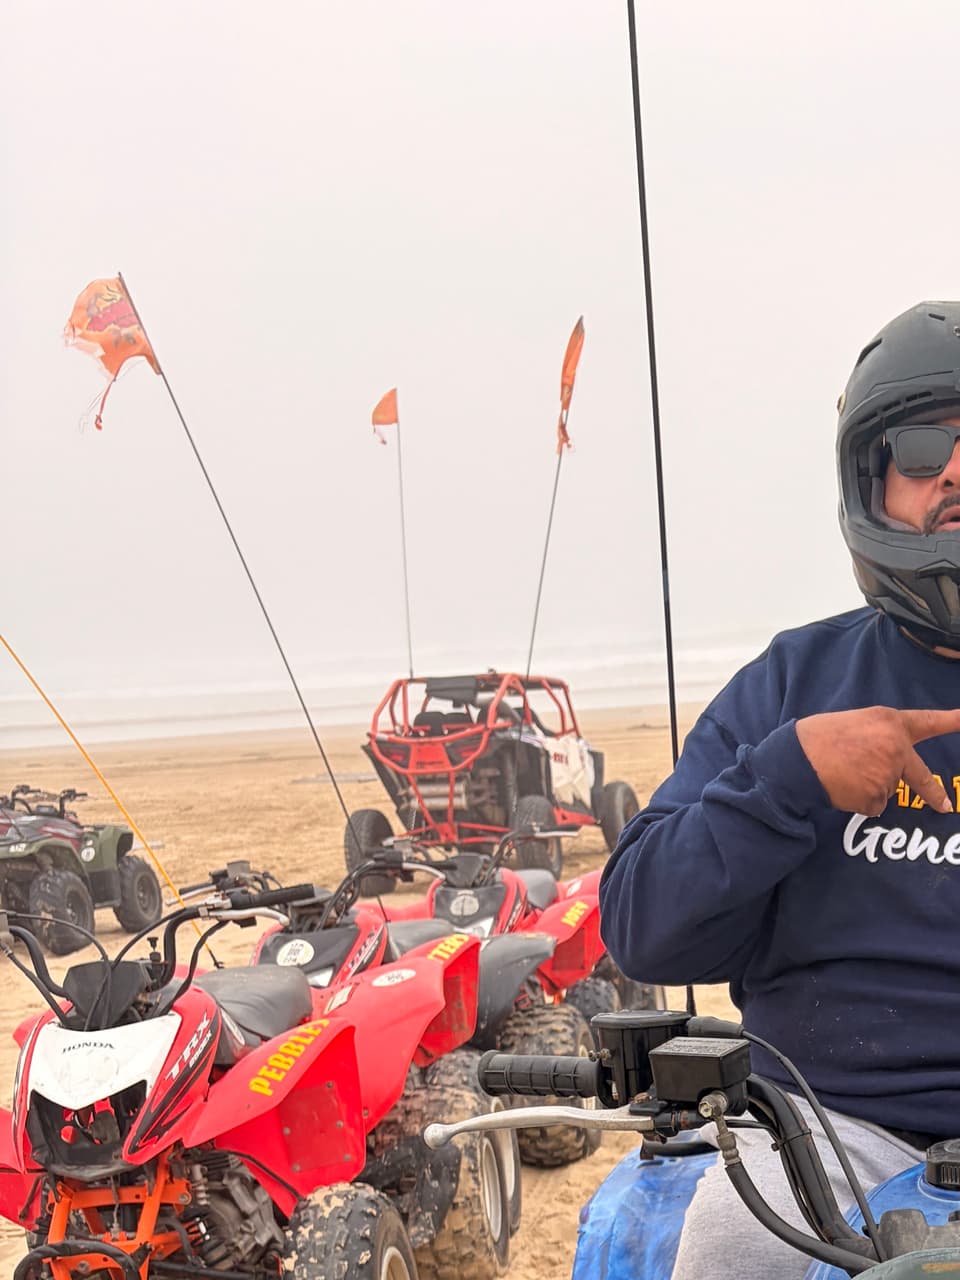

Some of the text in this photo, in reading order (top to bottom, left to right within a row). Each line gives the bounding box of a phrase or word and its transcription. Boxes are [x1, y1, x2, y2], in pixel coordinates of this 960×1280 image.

[62, 1041, 115, 1054] HONDA
[164, 1009, 210, 1080] TRX
[248, 1018, 330, 1096] PEBBLES
